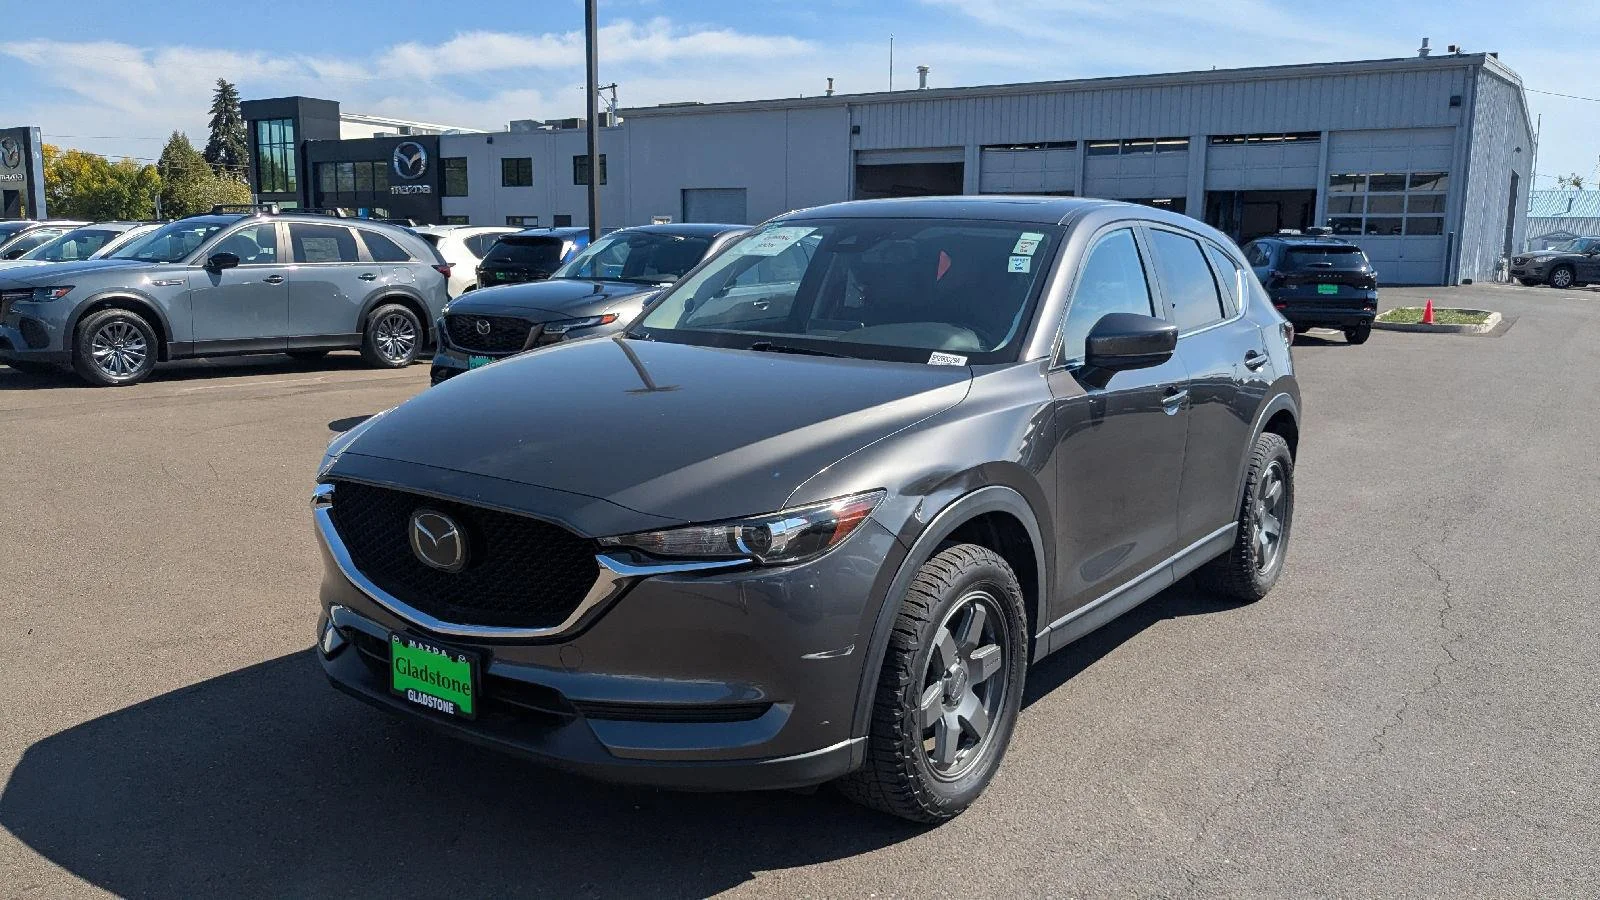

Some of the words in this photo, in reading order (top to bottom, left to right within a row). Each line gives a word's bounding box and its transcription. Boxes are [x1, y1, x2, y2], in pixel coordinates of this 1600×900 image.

[409, 640, 448, 657] MAZDA
[395, 657, 471, 697] Gladstone
[407, 689, 455, 715] GLADSTONE
